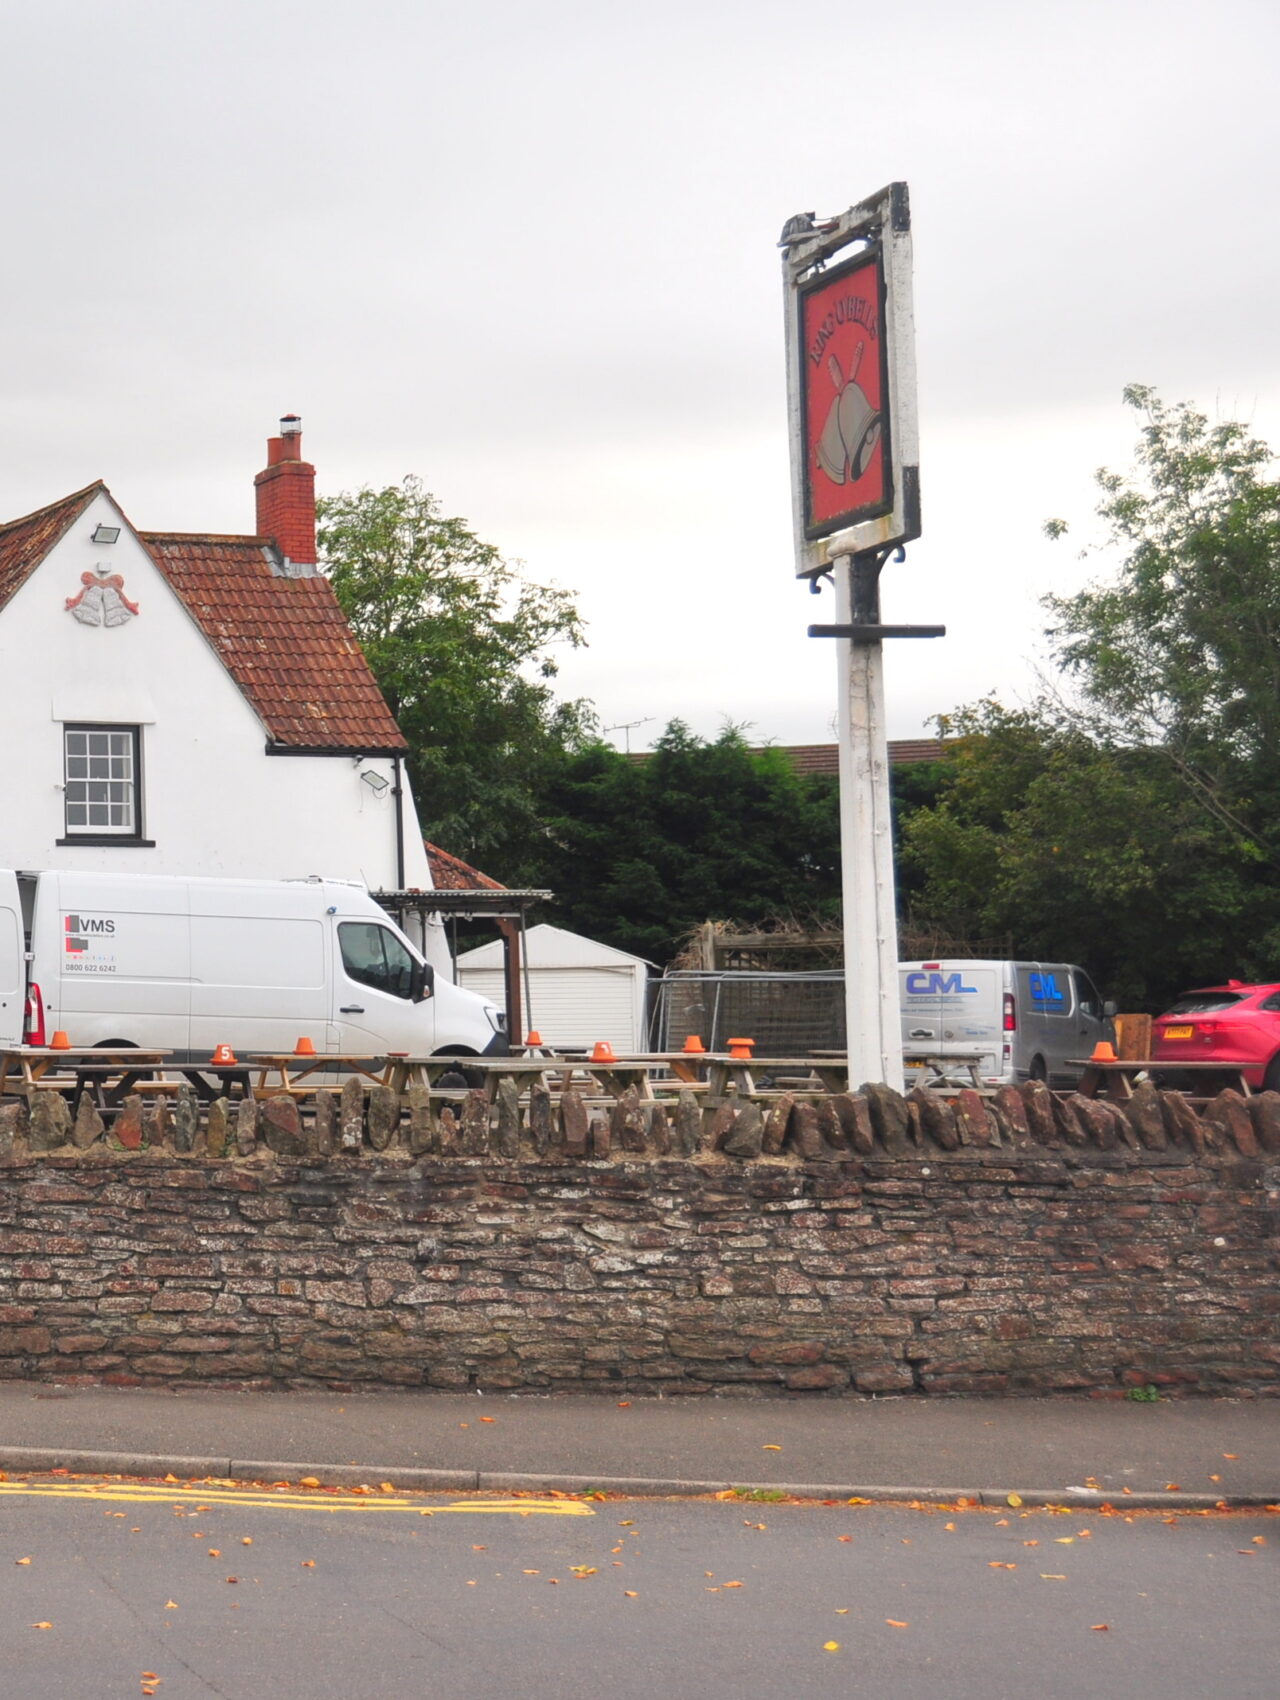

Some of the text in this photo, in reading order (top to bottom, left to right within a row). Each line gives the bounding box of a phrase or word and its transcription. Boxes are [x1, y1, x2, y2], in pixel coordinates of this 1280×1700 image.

[80, 919, 115, 933] VMS
[66, 963, 83, 971] 0800
[906, 973, 978, 994] CML
[221, 1047, 230, 1060] 5
